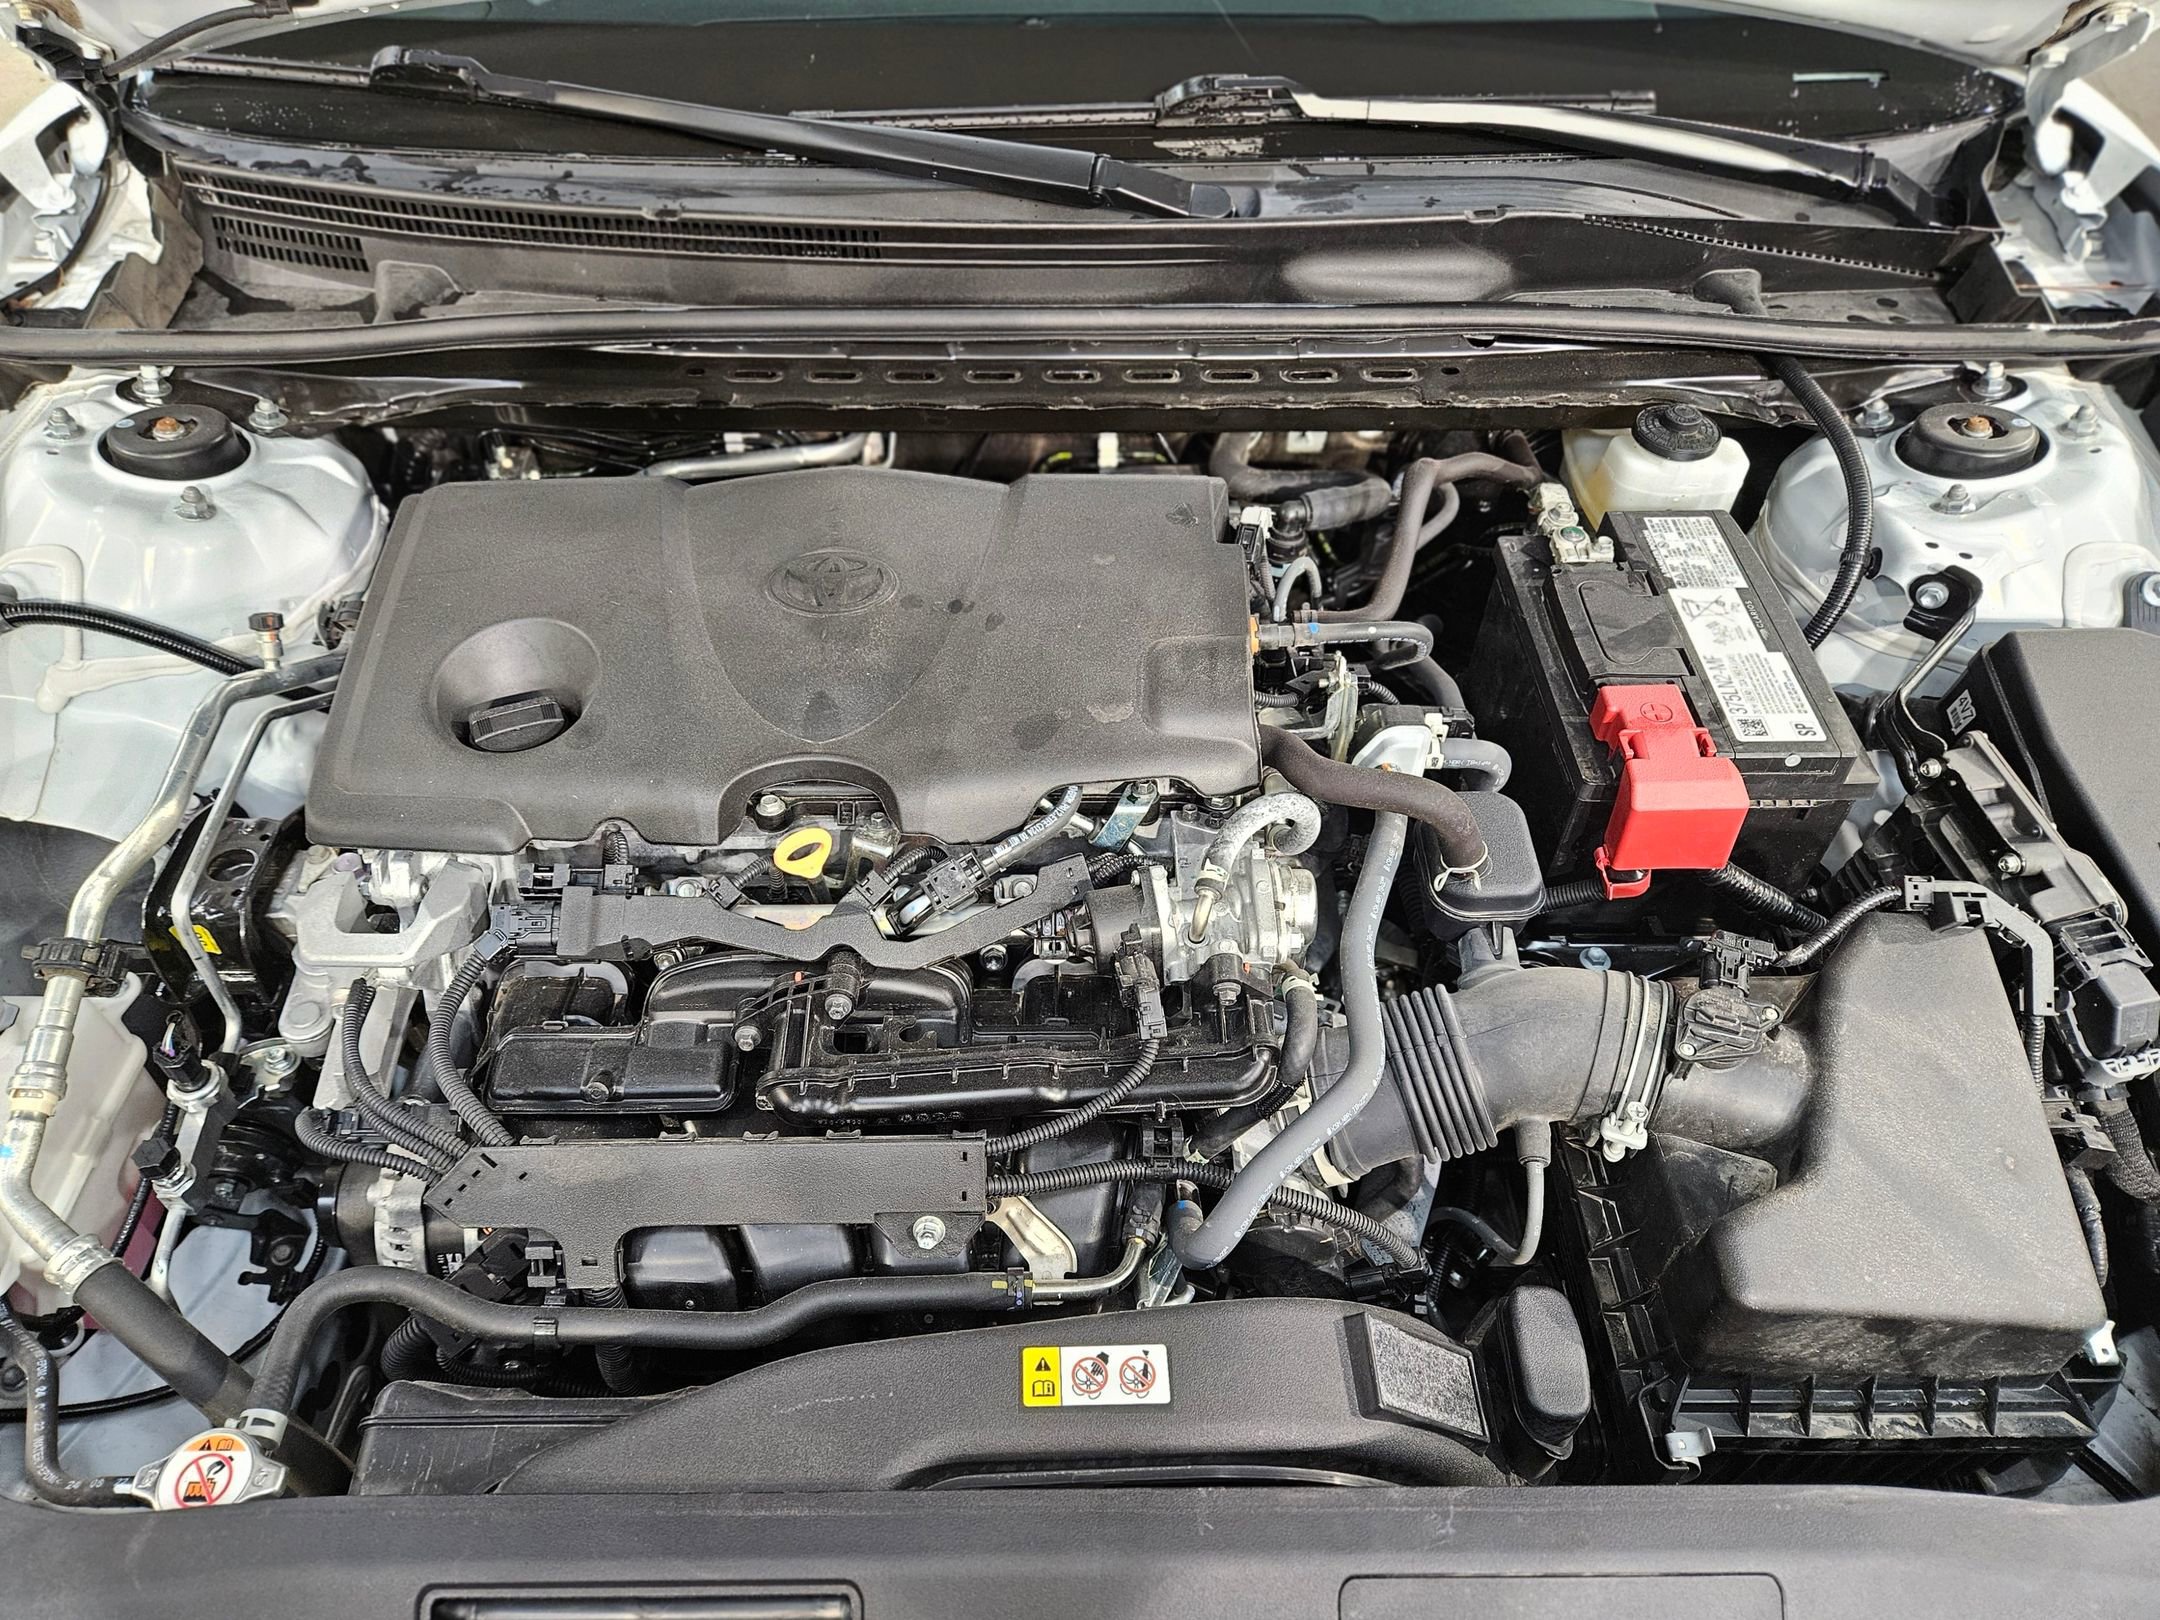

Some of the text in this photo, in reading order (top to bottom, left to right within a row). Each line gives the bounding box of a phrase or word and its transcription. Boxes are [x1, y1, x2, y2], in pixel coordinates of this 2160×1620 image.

[1744, 600, 1764, 629] CLARIOS
[1702, 654, 1748, 715] 375LN2-MF
[1959, 697, 1974, 720] 4V7
[1794, 723, 1817, 737] SP
